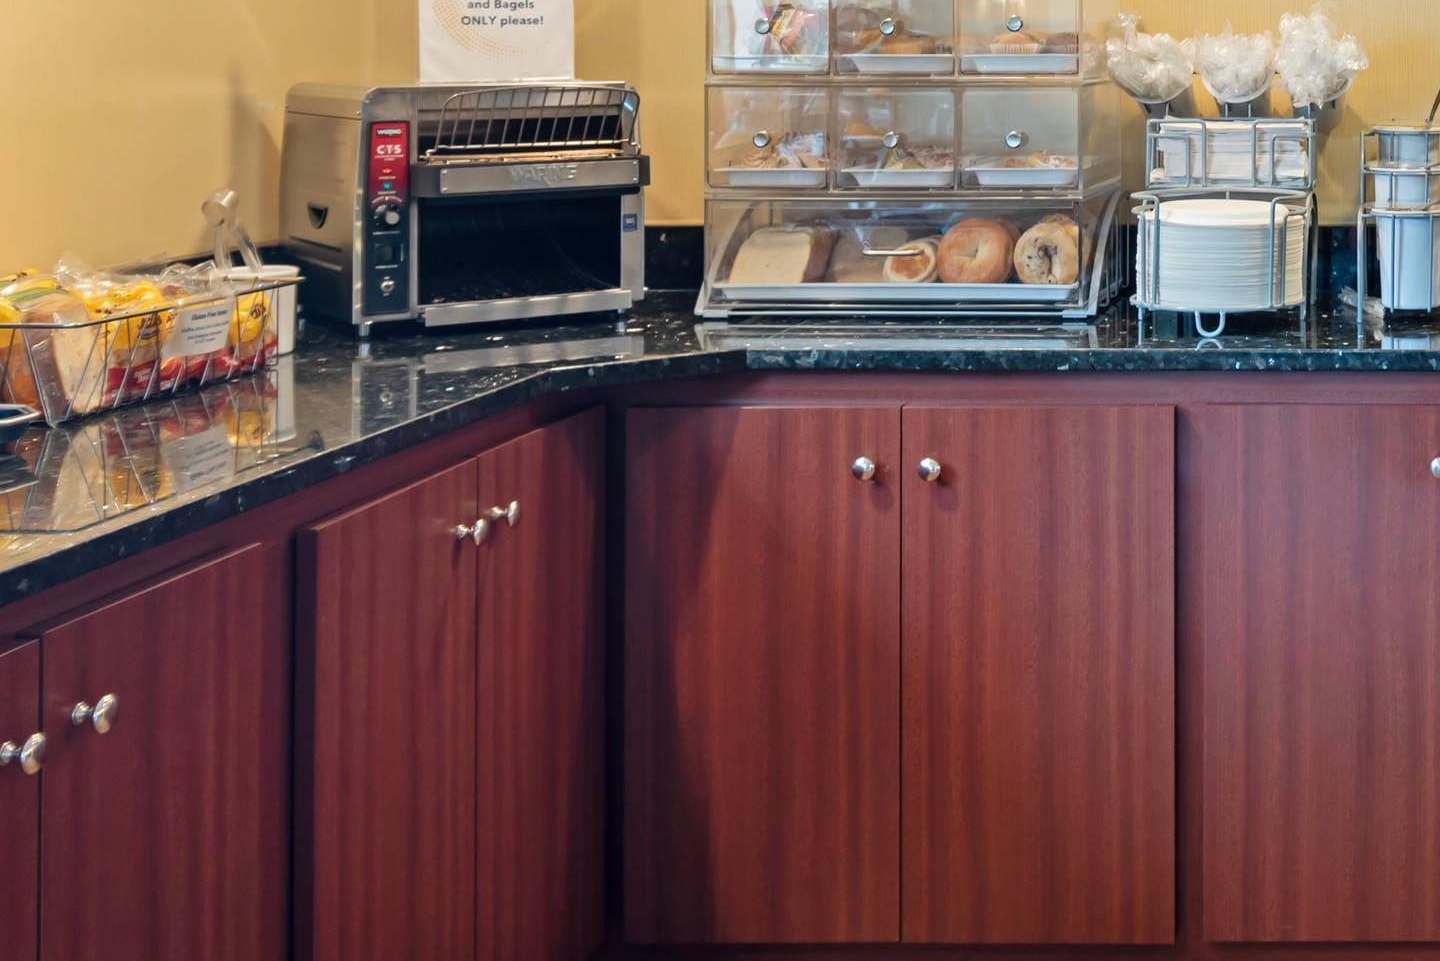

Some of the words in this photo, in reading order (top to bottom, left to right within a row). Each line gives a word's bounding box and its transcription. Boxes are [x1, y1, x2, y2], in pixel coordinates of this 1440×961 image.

[467, 0, 490, 9] and
[494, 0, 535, 12] Bagels
[461, 15, 497, 26] ONLY
[500, 15, 544, 28] please!
